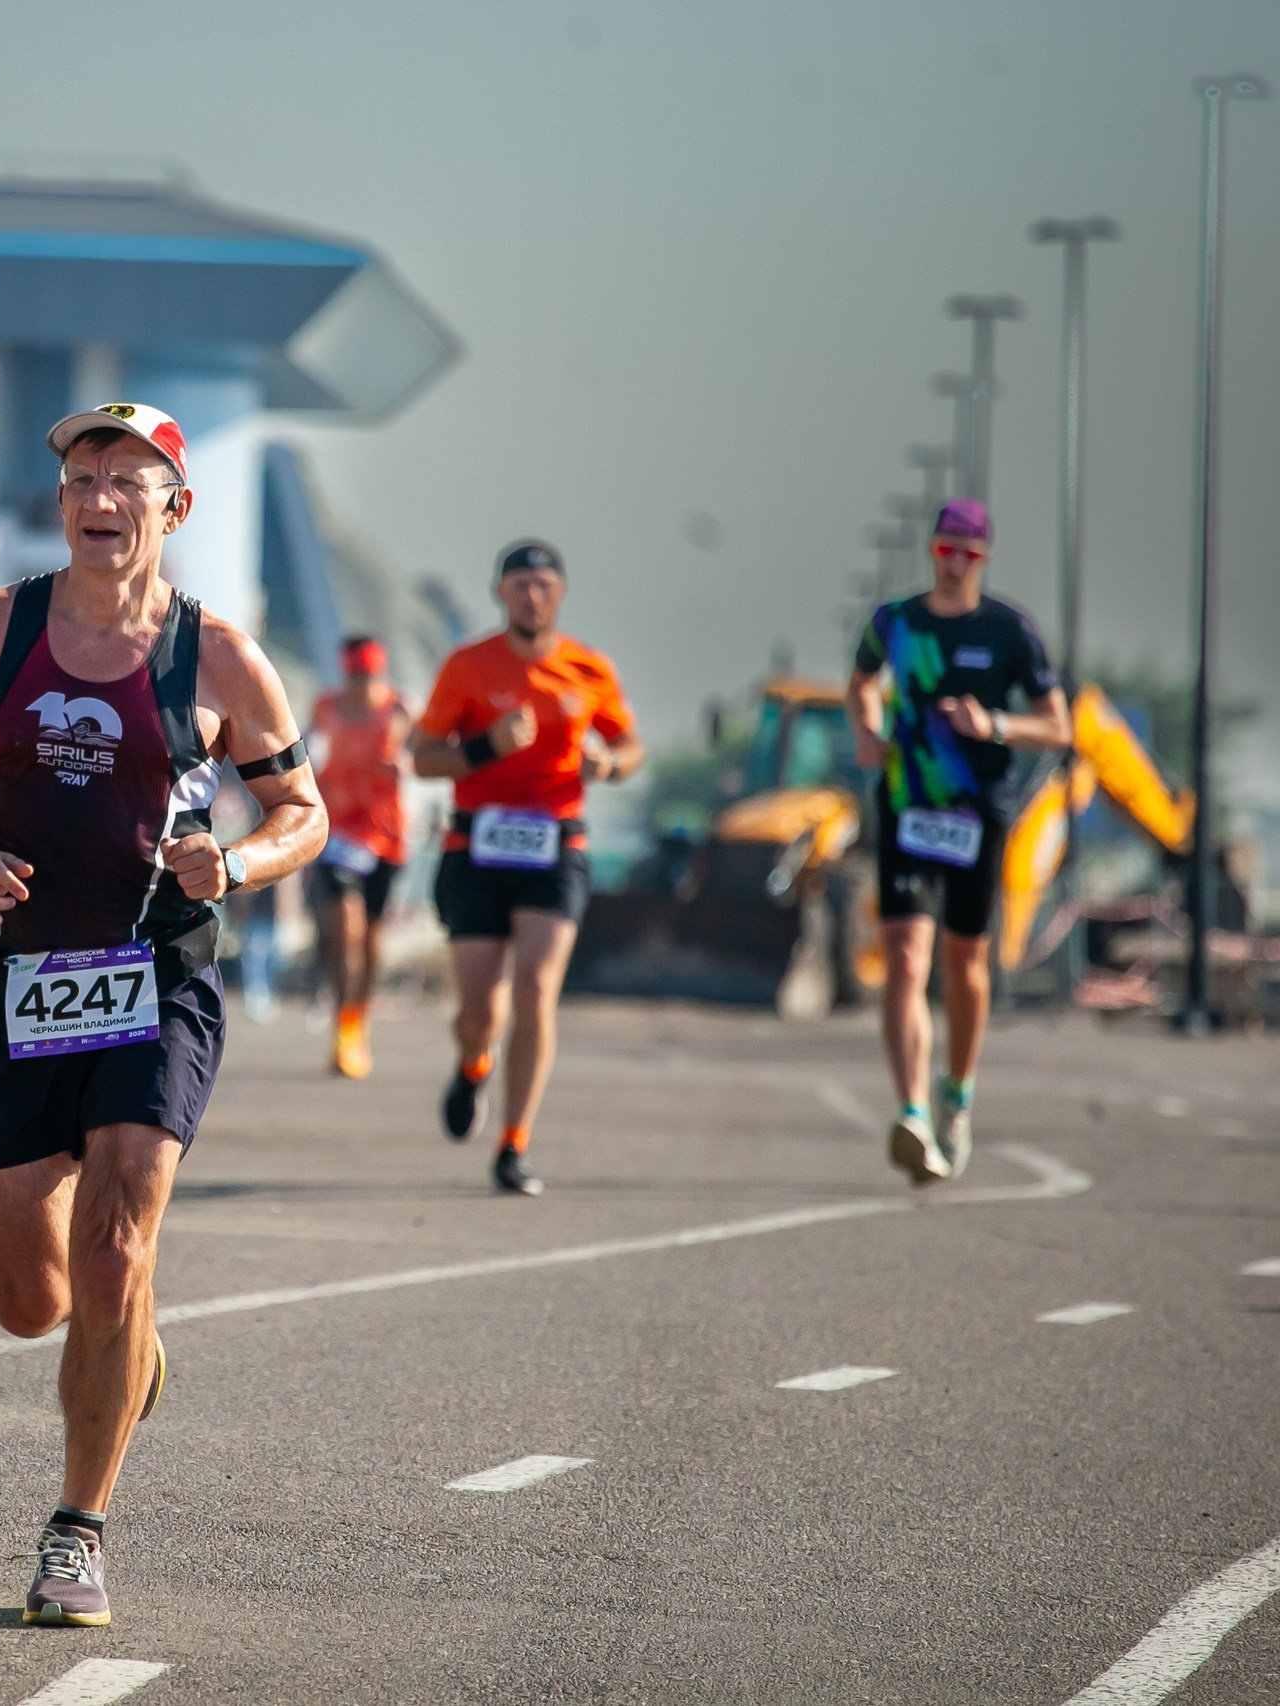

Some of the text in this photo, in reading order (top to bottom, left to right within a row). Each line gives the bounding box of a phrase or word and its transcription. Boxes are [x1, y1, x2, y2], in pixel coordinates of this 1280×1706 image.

[36, 742, 115, 765] SIRIUS
[36, 756, 113, 775] AUTODROM
[52, 949, 106, 960] КРАСНОЯРСКИЕ
[67, 956, 92, 965] МОСТЫ
[15, 970, 145, 1023] 4247
[30, 1016, 136, 1035] ЧЕРКАШИН ВЛАДИМИР
